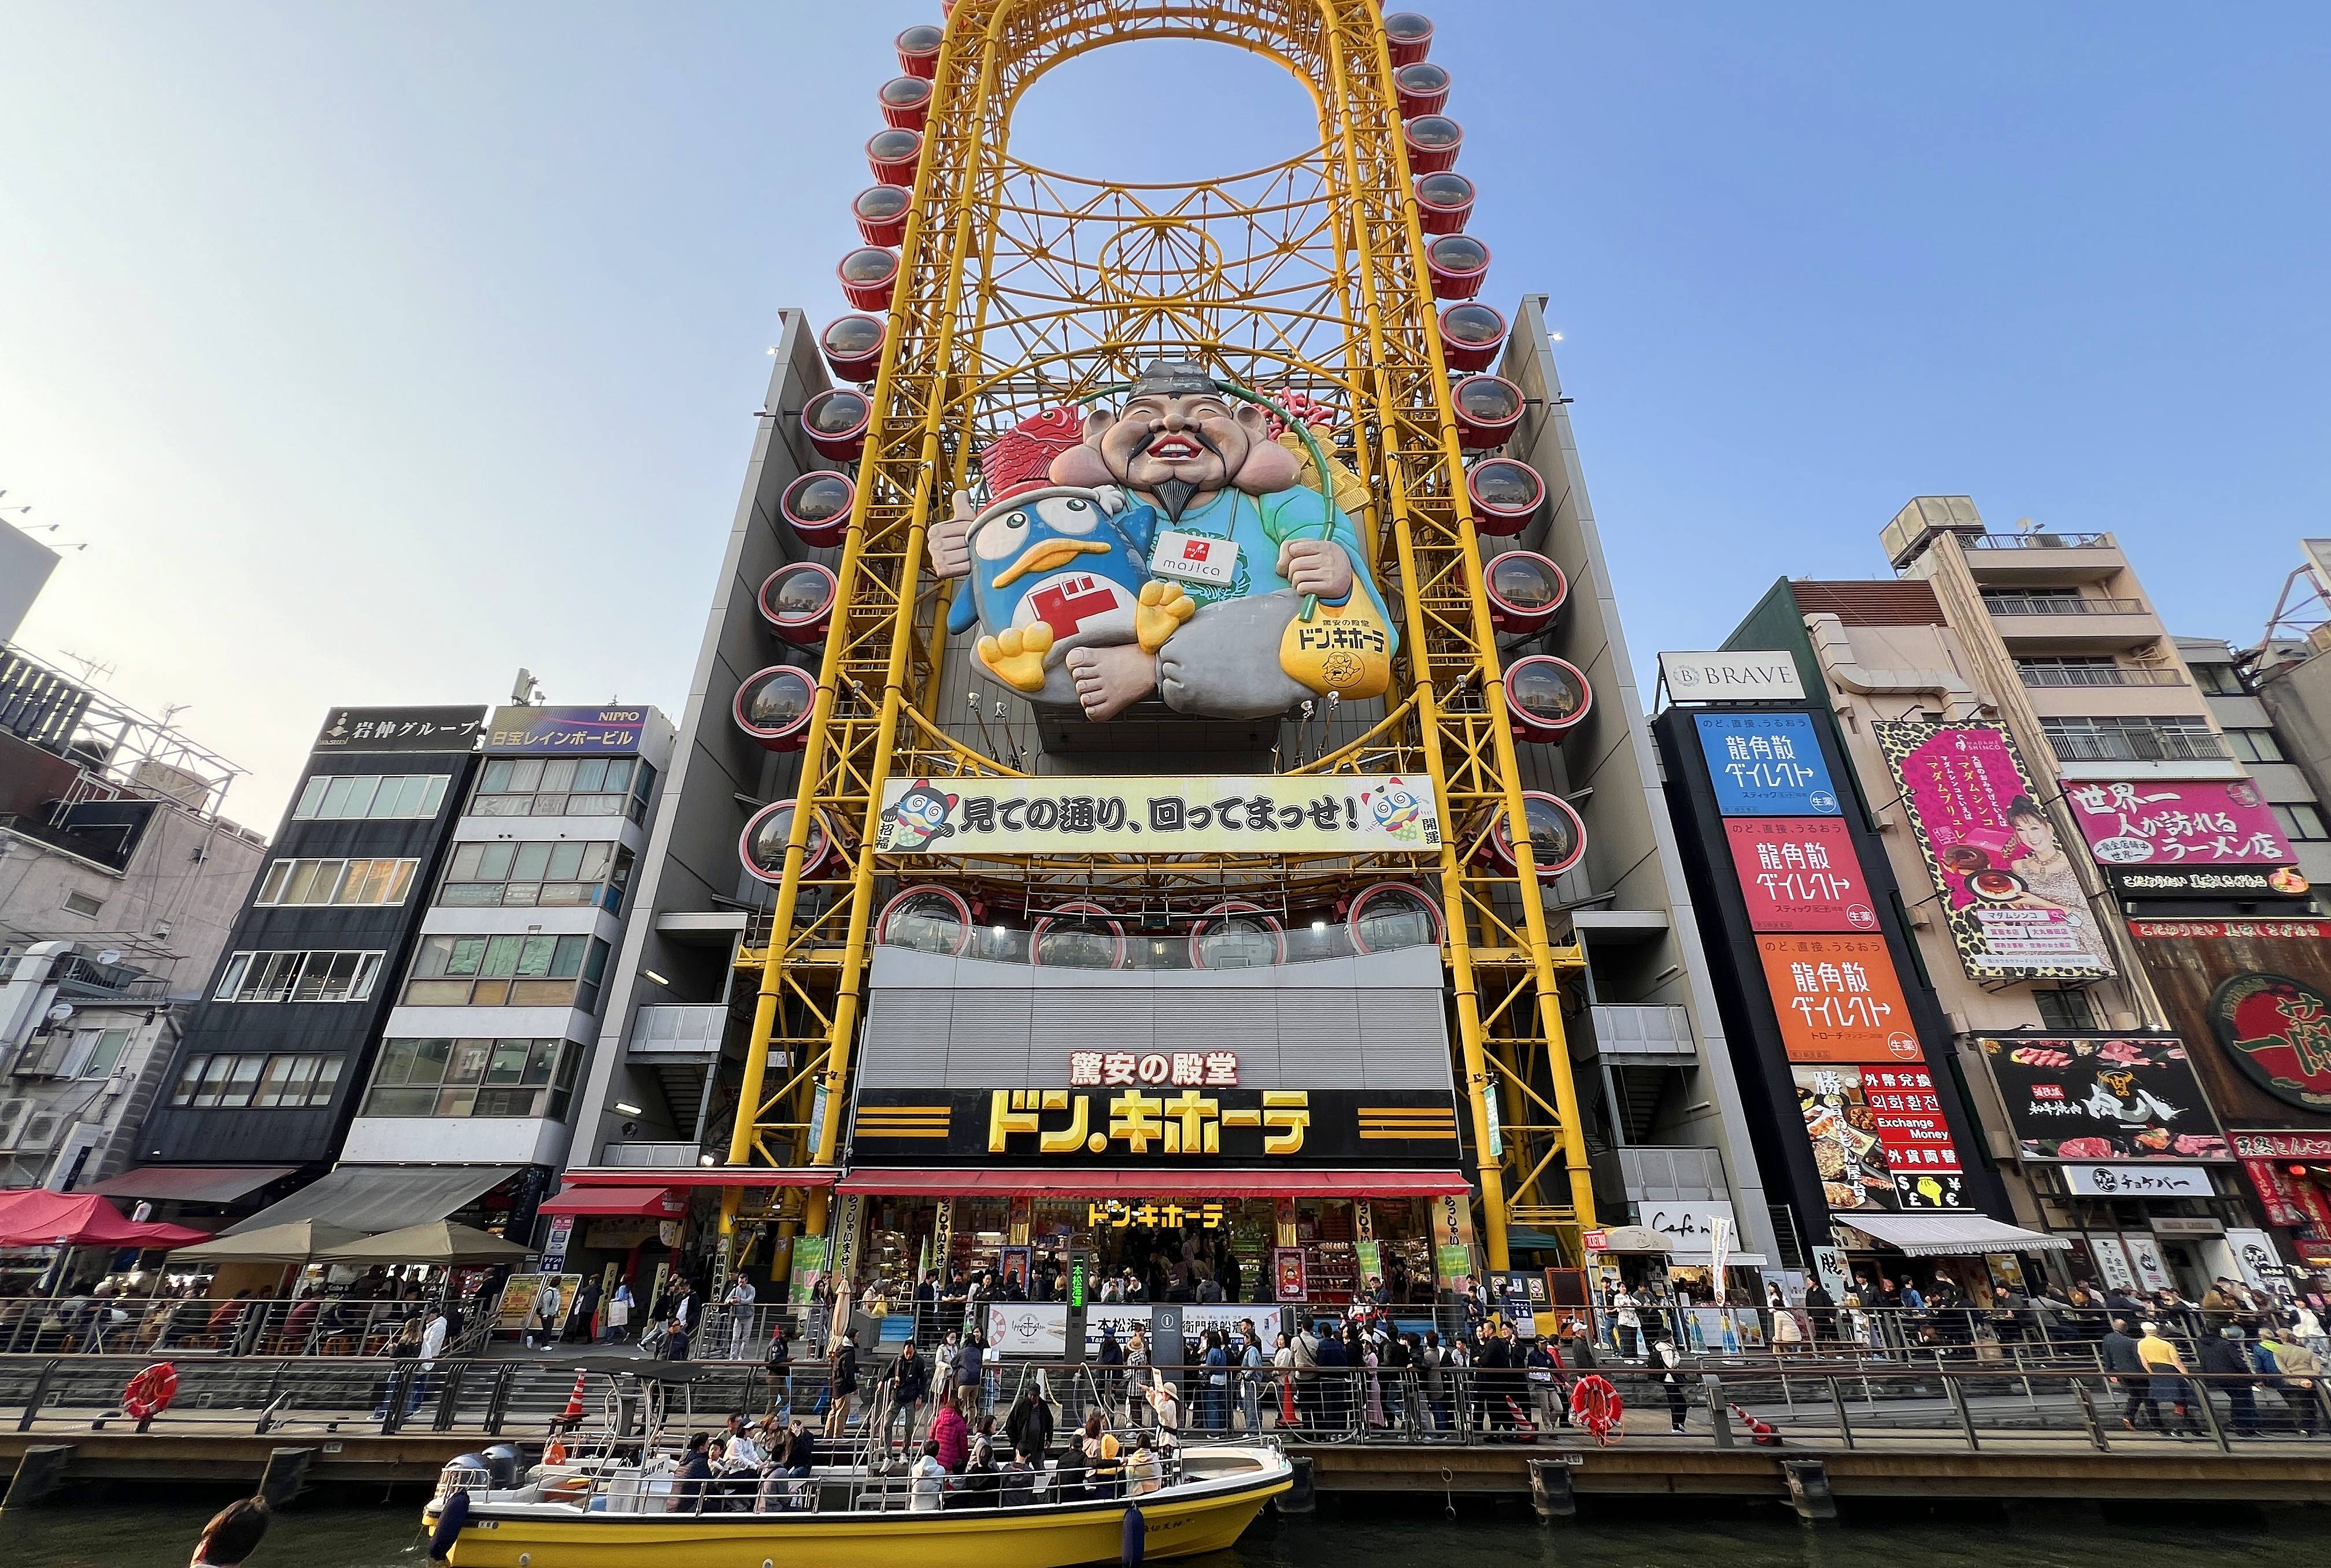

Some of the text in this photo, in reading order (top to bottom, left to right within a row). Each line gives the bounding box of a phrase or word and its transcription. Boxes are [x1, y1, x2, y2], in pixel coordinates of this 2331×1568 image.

[1322, 619, 1370, 627] 驚安の殿堂
[1703, 667, 1793, 684] BRAVE
[598, 711, 639, 722] NIPPO
[491, 731, 632, 746] 日宝レインボービル
[1725, 735, 1796, 761] 龍角散
[1725, 763, 1814, 788] ダイレクト
[2072, 782, 2181, 815] 世界一
[1423, 818, 1441, 844] 開運
[2118, 811, 2237, 837] 人が訪れる
[875, 822, 894, 849] 招福
[2161, 832, 2283, 861] ラーメン店
[1756, 842, 1832, 869] 龍角散
[2111, 850, 2151, 861] 世界一
[1756, 873, 1849, 900] ダイレクト
[1849, 911, 1873, 921] 生薬
[1790, 962, 1871, 993] 龍角散
[1791, 997, 1890, 1027] ダイレクト
[1890, 1040, 1915, 1051] 生薬
[1070, 1050, 1239, 1085] 驚安の殿堂
[1871, 1094, 1940, 1111] 외화환전
[2029, 1100, 2082, 1116] 和牛焼肉
[1877, 1118, 1934, 1129] Exchange
[1910, 1129, 1948, 1141] Money
[1888, 1149, 1956, 1164] 外貨両替
[1899, 1176, 1962, 1192] $ ¥
[1909, 1192, 1959, 1207] £ €
[1652, 1212, 1694, 1237] Cafe
[1071, 1259, 1084, 1306] 一本松海運
[1183, 1320, 1255, 1333] 衛門橋船着
